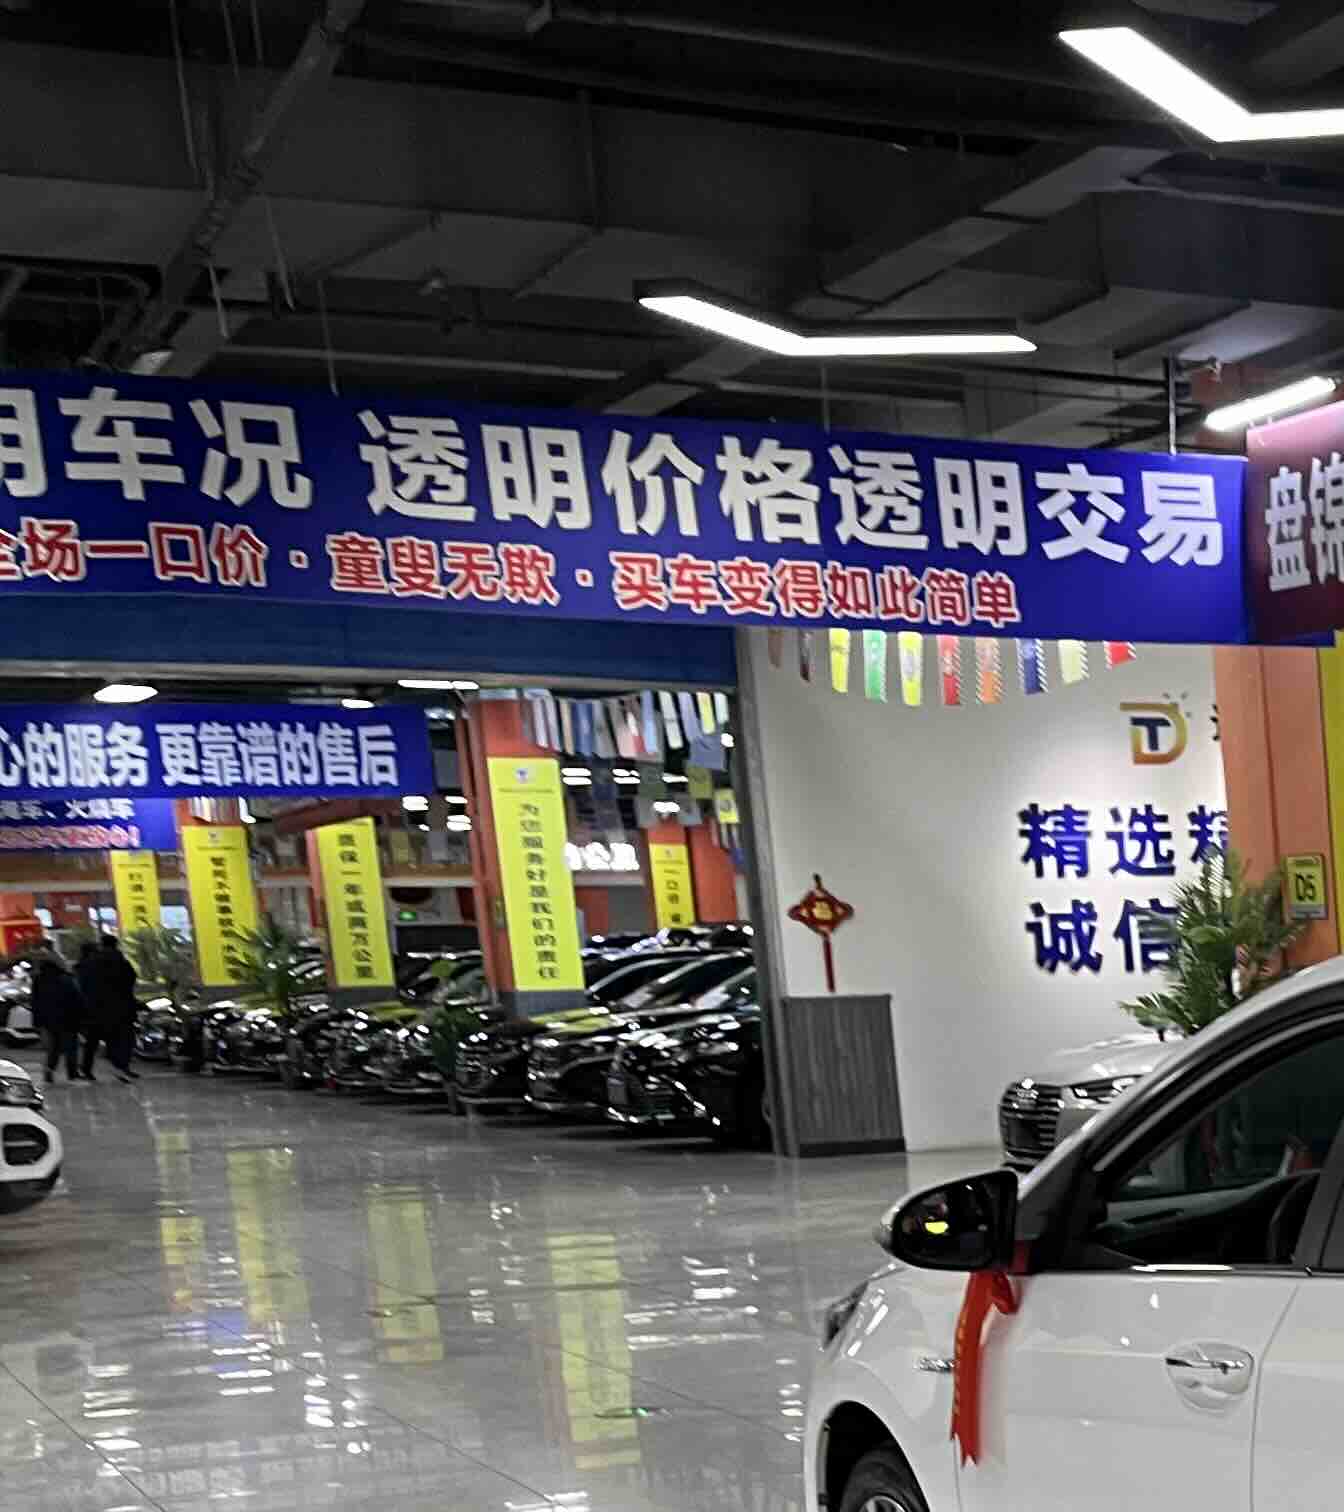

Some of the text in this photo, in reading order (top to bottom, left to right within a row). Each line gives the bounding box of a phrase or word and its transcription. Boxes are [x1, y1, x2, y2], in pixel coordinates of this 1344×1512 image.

[356, 408, 1224, 567] 透明价格透明交易
[155, 722, 400, 788] 更靠谱的售后
